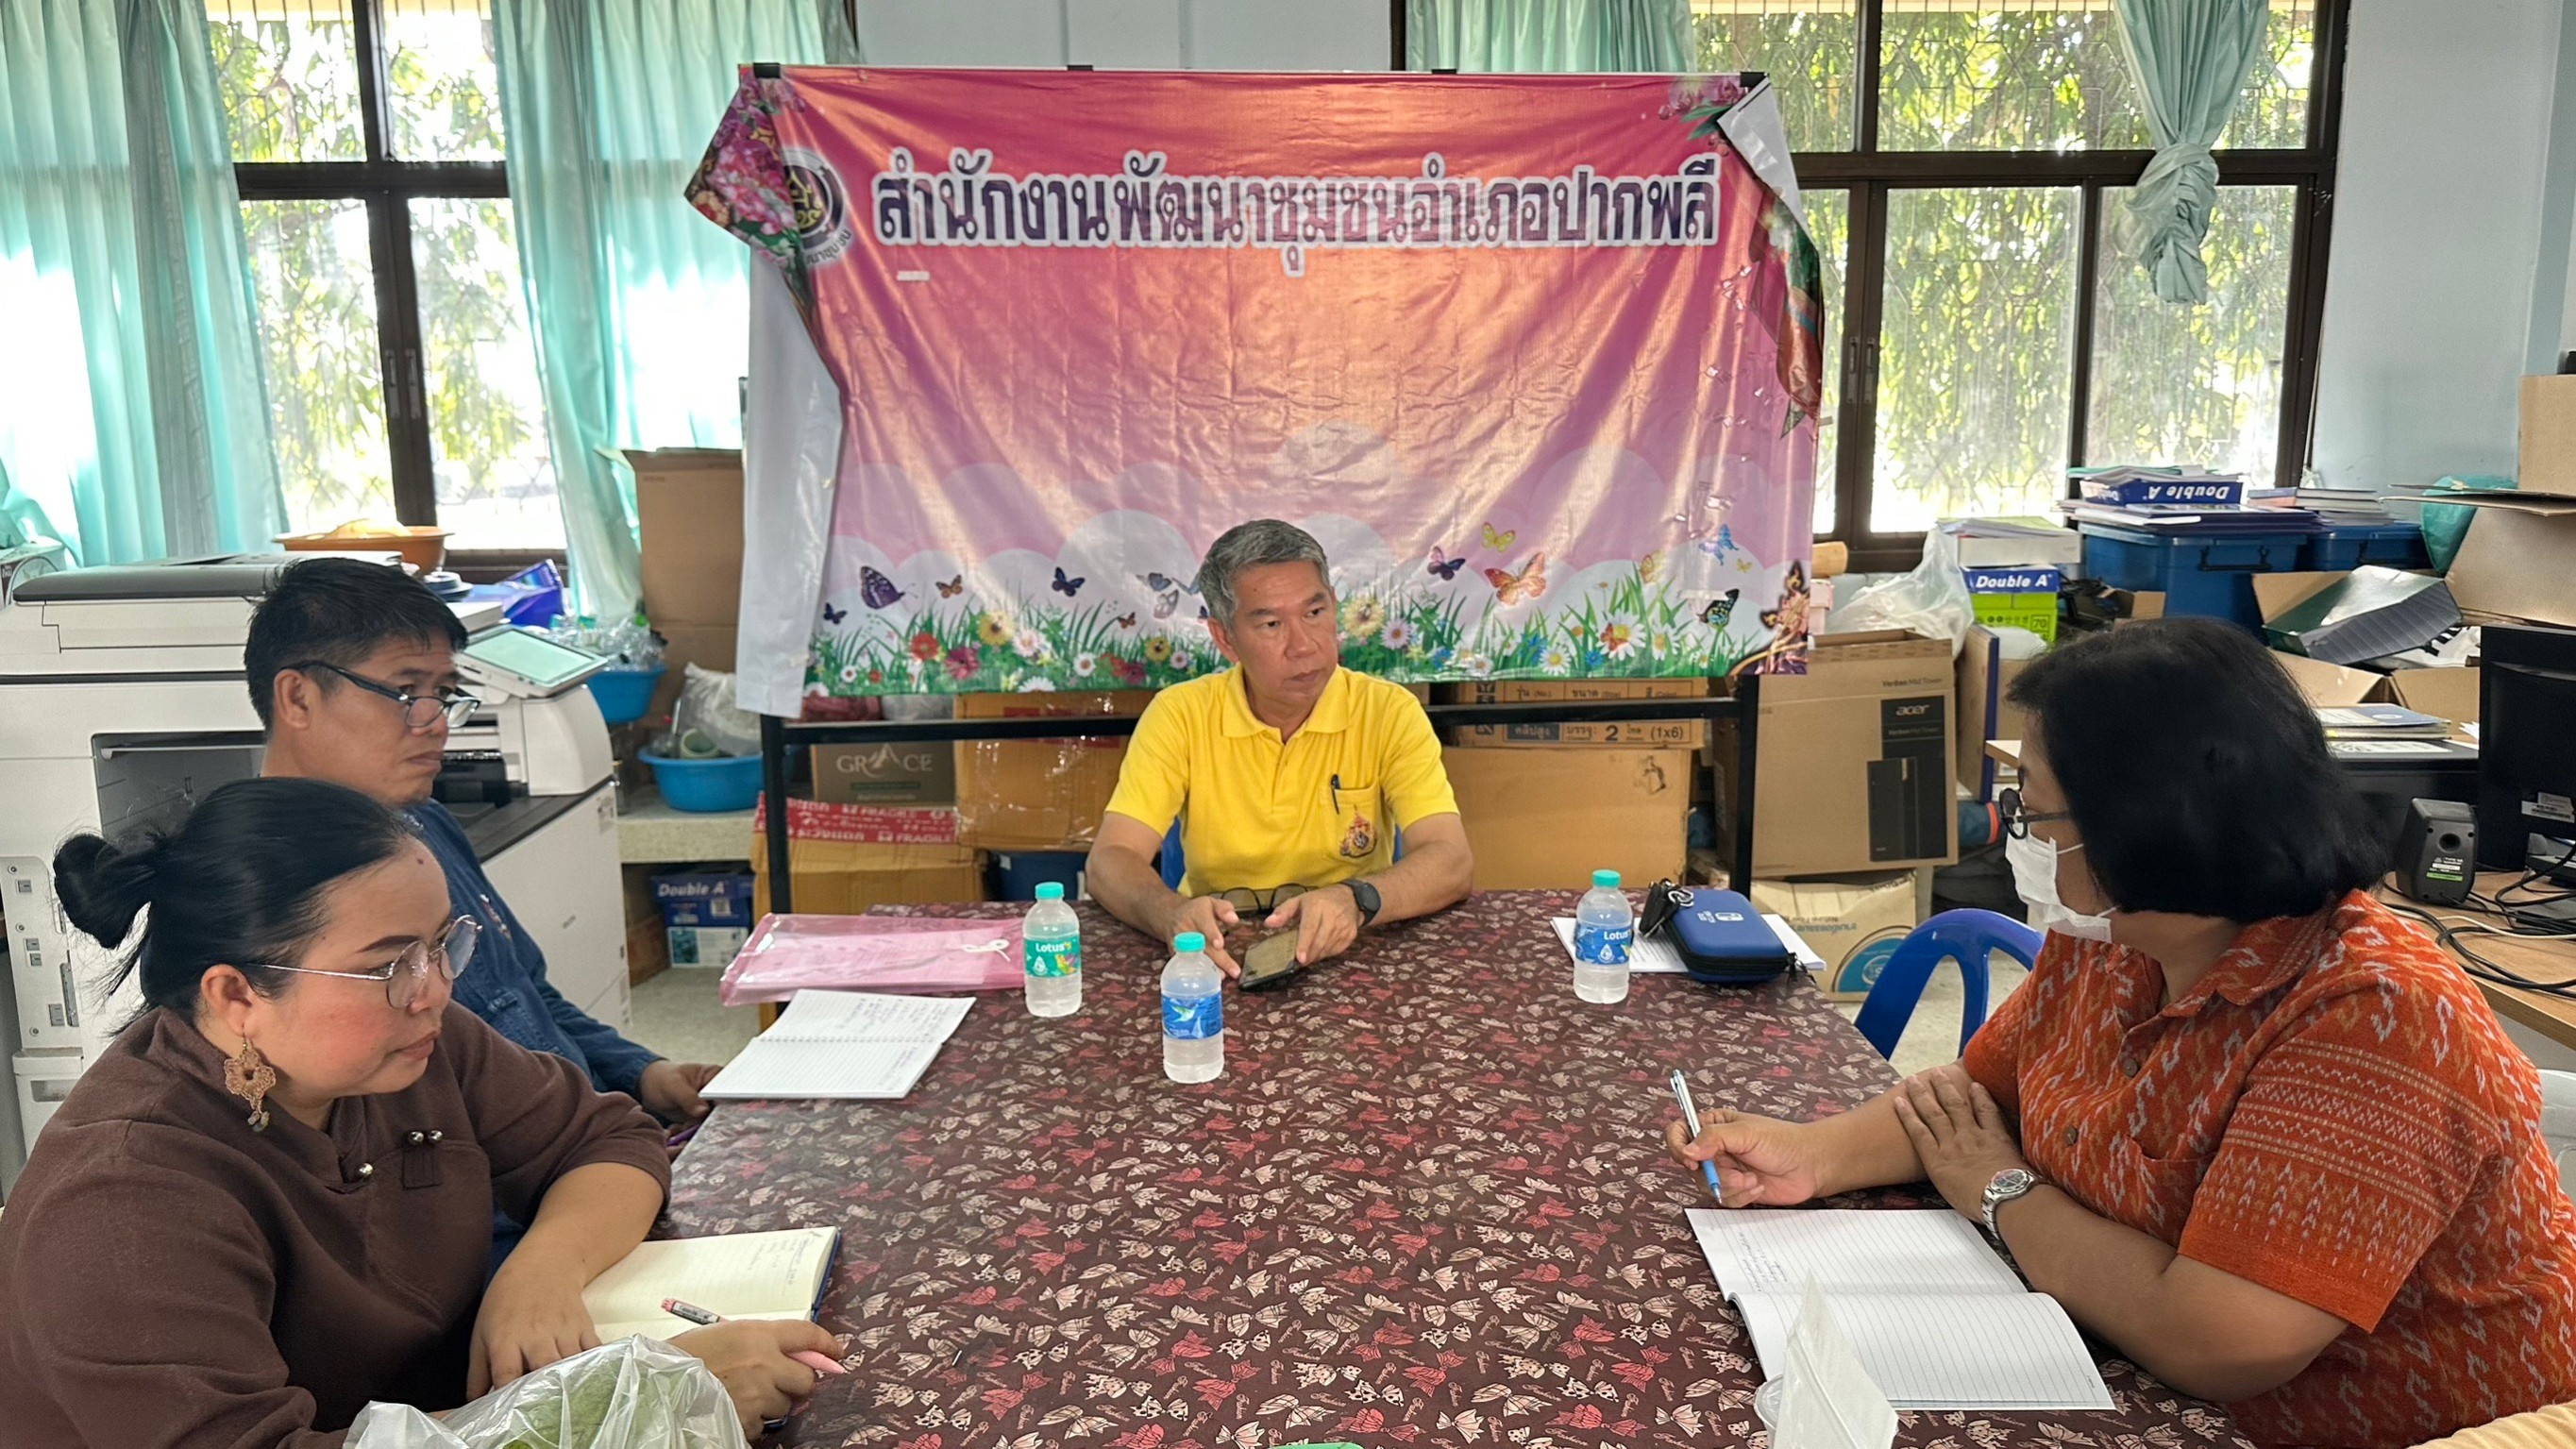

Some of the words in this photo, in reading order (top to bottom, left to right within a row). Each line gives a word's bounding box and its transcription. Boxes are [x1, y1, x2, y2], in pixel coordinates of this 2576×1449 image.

[873, 149, 1719, 275] สำนักงานพัฒนาชุมชนอำเภอปากพลี
[2147, 485, 2164, 497] A
[2166, 484, 2231, 499] Double
[1975, 573, 2030, 589] Double
[2034, 573, 2049, 587] A
[2033, 618, 2047, 629] 70
[1922, 676, 1943, 684] Tower
[1895, 704, 1930, 716] acer
[1605, 725, 1618, 741] 2
[1650, 725, 1684, 740] (1x6)
[836, 743, 934, 778] GRACE
[896, 832, 952, 842] FRAGILE
[658, 882, 710, 898] Double
[713, 881, 726, 895] A
